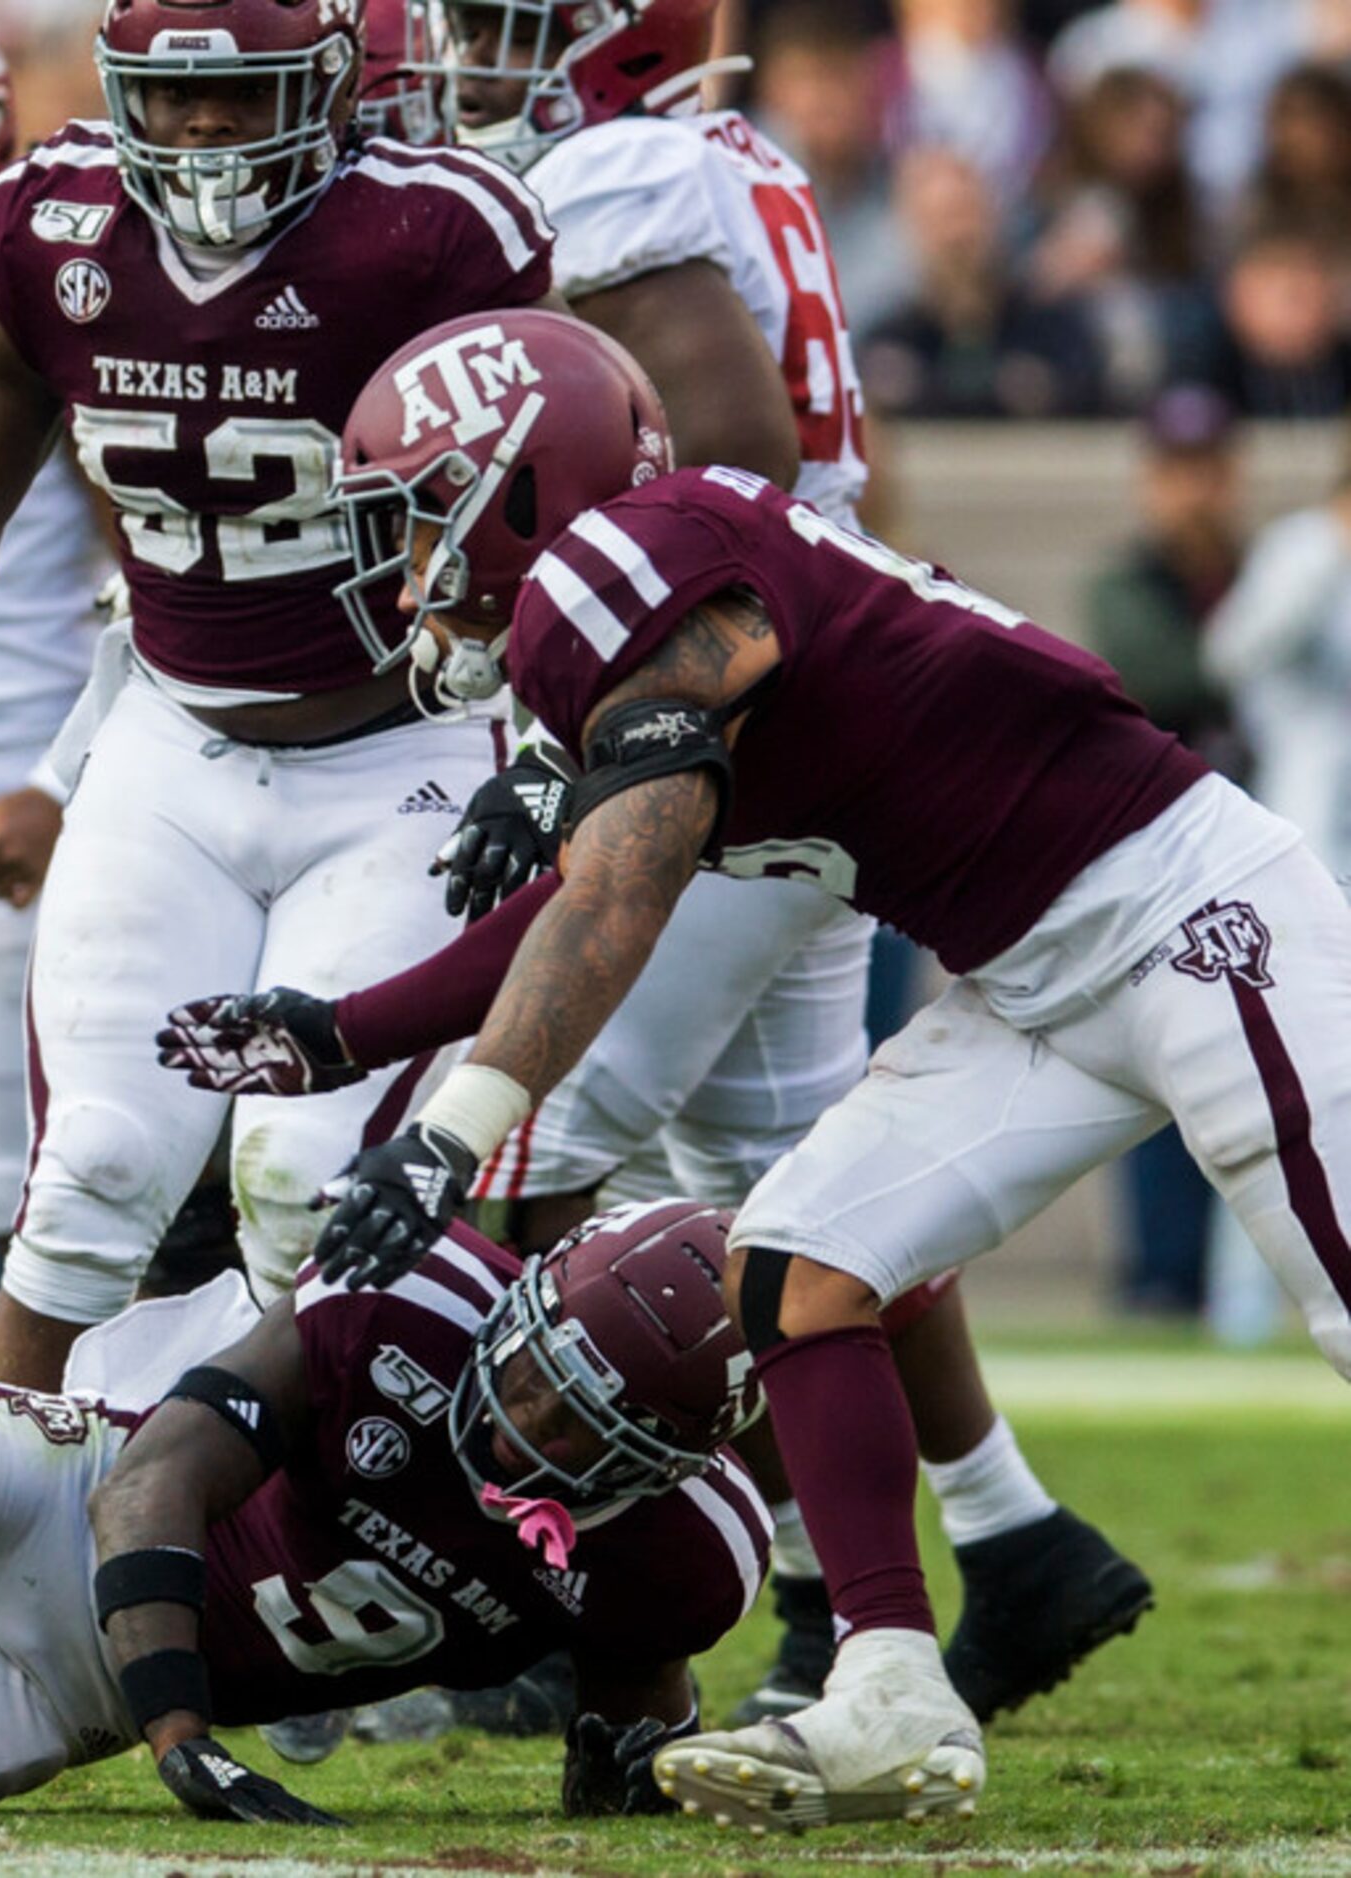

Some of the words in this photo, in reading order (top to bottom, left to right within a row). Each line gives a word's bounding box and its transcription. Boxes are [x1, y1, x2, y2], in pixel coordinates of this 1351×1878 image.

[60, 264, 105, 318] SEC
[92, 355, 206, 401] TEXAS
[219, 365, 298, 404] A&M
[72, 401, 353, 582] 52
[352, 1423, 406, 1474] SEC
[338, 1499, 456, 1588] TEXAS
[451, 1577, 519, 1635] A&M
[251, 1559, 445, 1676] 9
